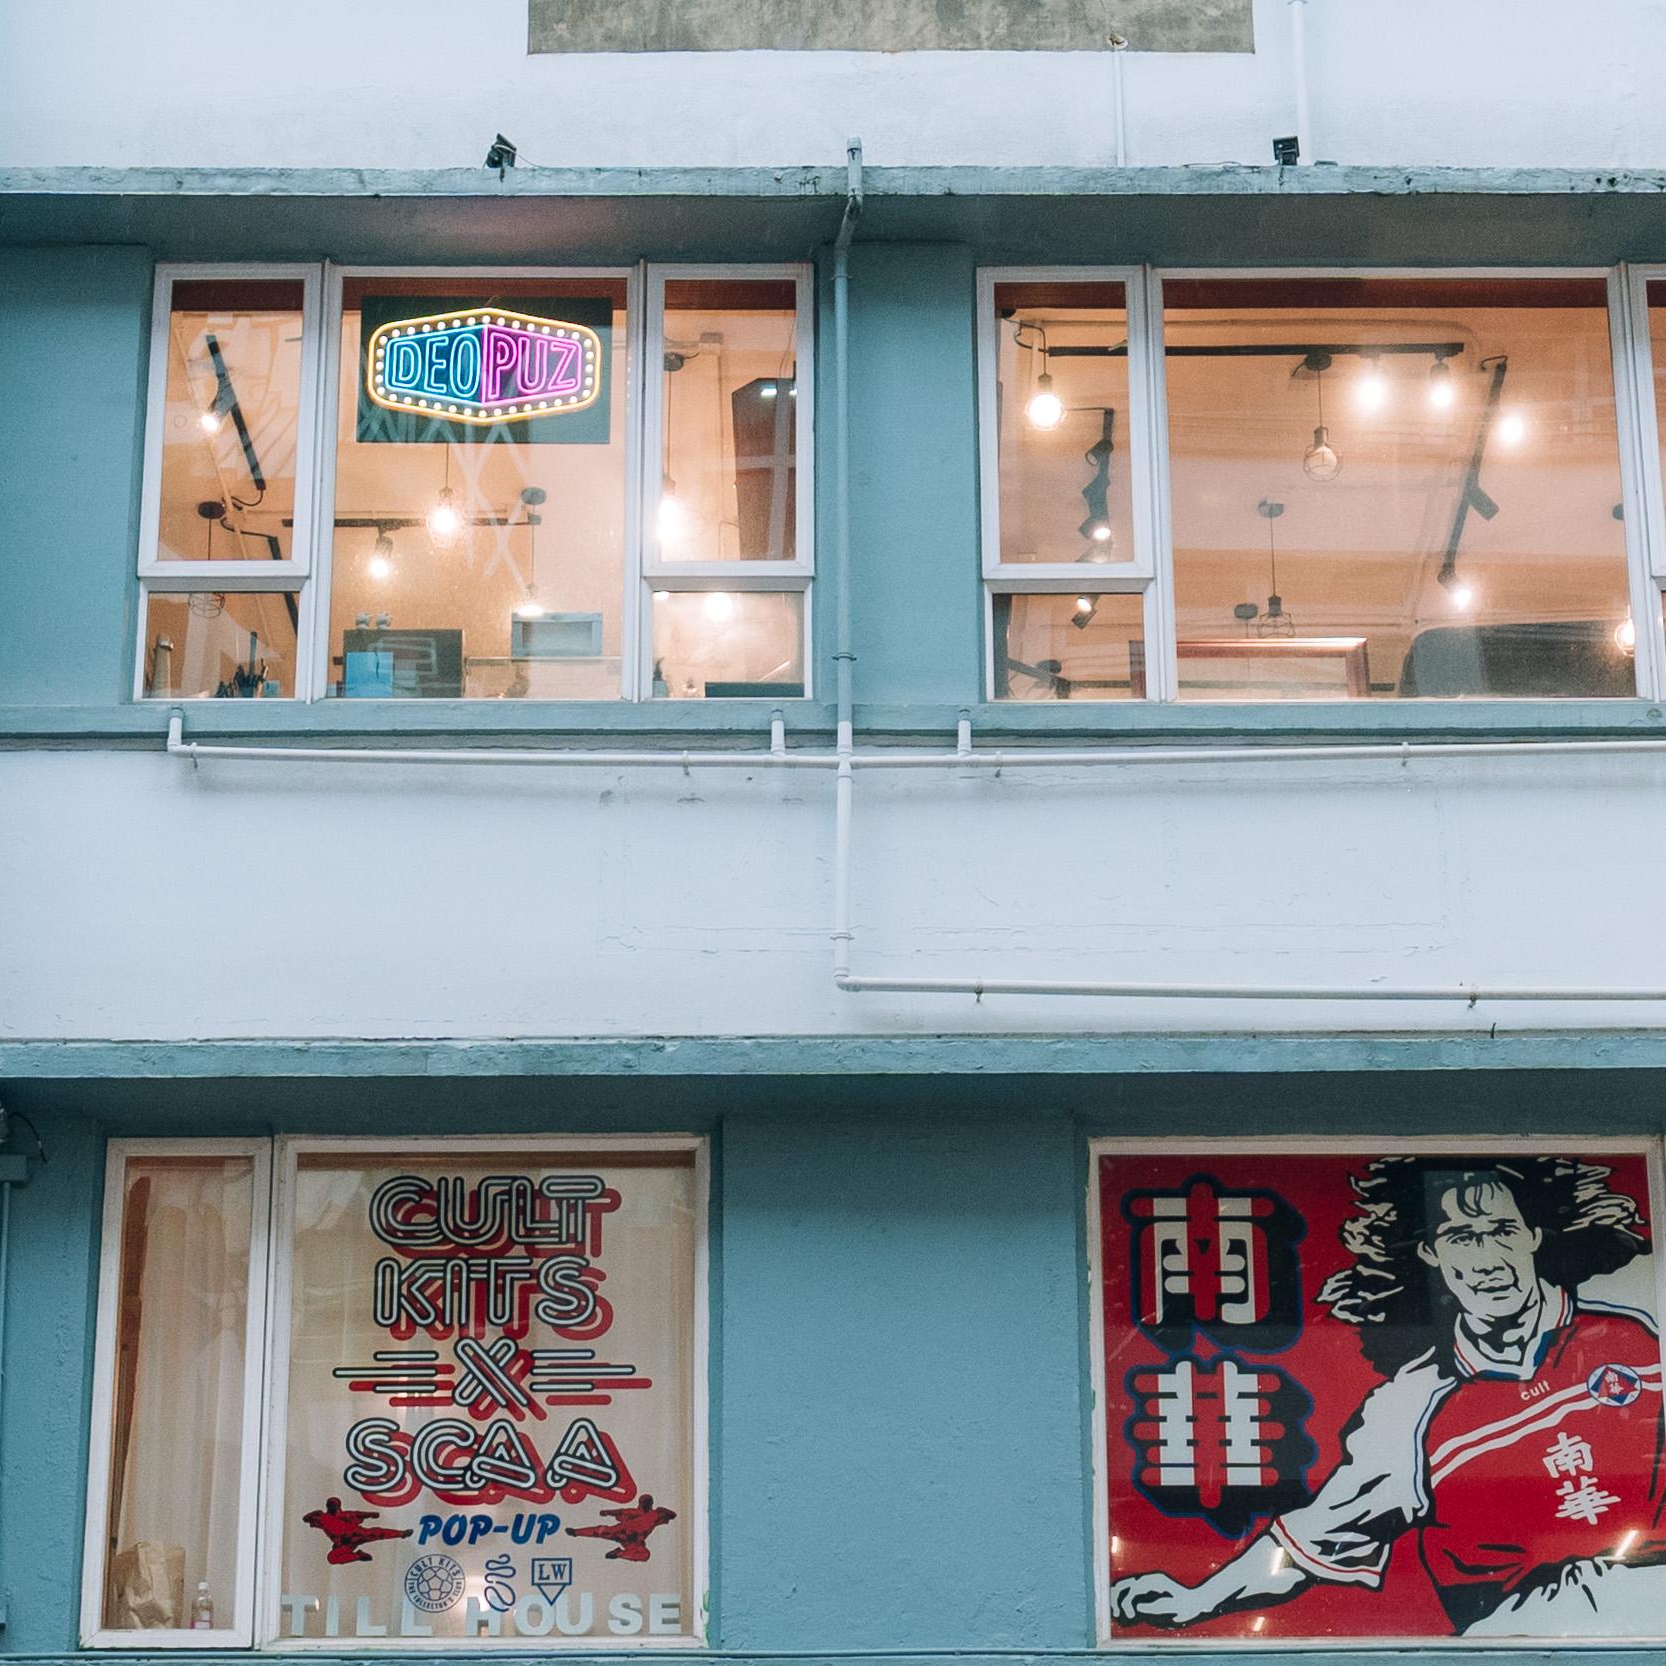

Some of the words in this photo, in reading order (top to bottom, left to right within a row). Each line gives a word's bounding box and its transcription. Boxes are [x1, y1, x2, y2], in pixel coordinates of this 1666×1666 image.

[369, 1175, 604, 1247] CULT
[373, 1255, 597, 1327] KITS
[1520, 1380, 1551, 1401] cult
[344, 1417, 619, 1492] SCAA
[1542, 1431, 1622, 1525] 南華
[418, 1513, 562, 1546] POP-UP
[538, 1563, 568, 1582] LW
[465, 1592, 682, 1636] HOUSE
